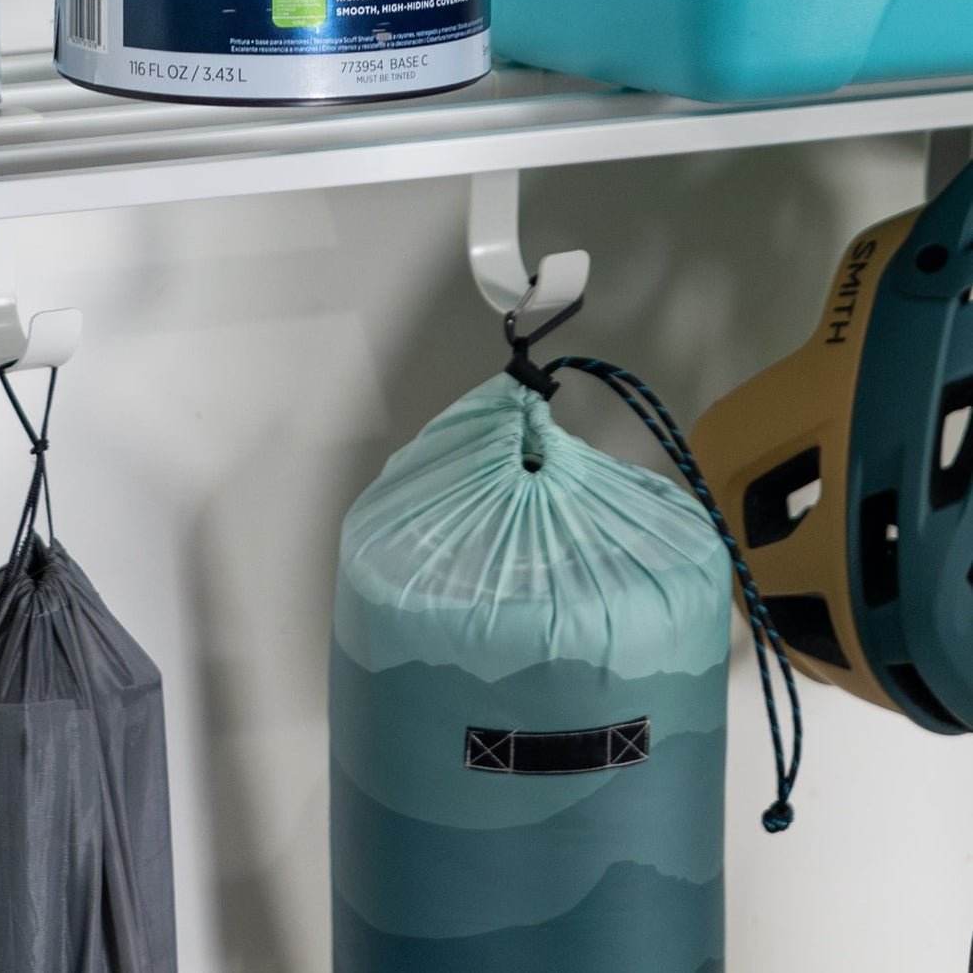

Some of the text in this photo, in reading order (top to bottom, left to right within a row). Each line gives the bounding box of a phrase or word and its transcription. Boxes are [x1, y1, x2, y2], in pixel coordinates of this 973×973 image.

[336, 2, 380, 16] SMOOTH,
[129, 60, 247, 82] 116 FL OZ / 3.43 L
[340, 54, 428, 74] 773954 BASE C
[356, 71, 416, 83] MUST BE TINTED
[826, 239, 877, 344] SMITH
